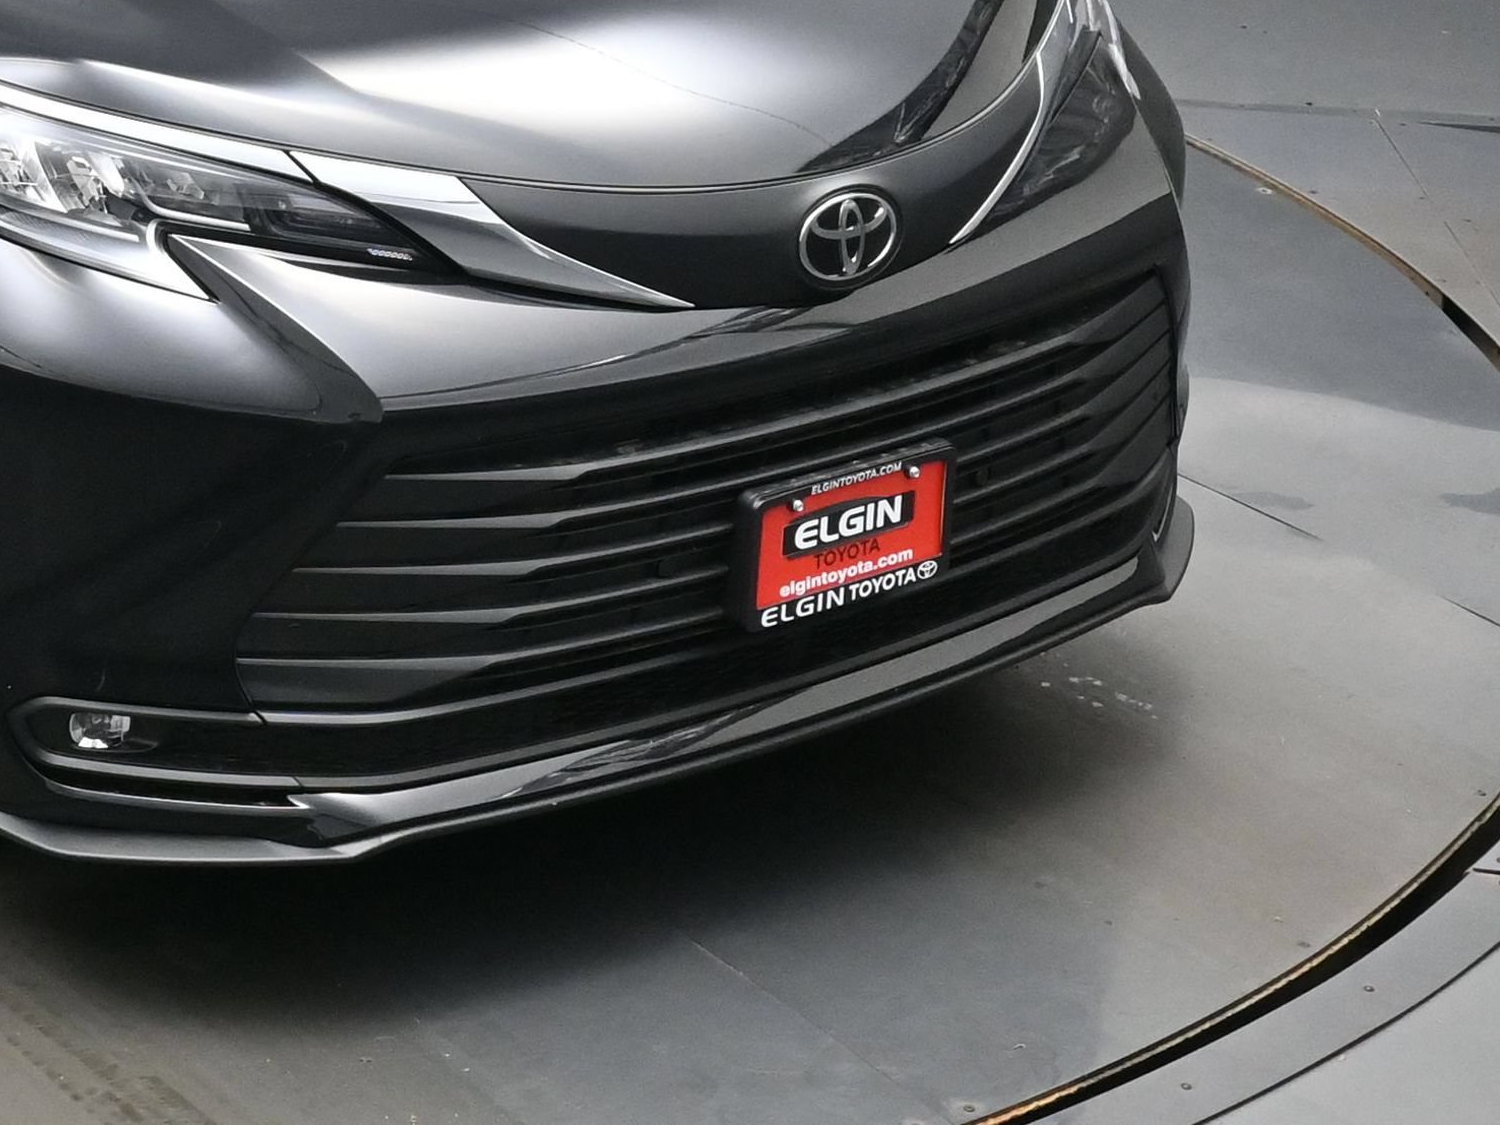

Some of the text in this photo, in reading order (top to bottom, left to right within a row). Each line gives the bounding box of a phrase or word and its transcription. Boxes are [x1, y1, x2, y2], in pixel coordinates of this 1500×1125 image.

[811, 461, 902, 495] ELGINTOYOTA.COM
[794, 495, 902, 550] ELGIN
[779, 548, 913, 597] elgintoyota.com
[813, 538, 881, 569] TOYOTA
[761, 568, 917, 627] ELGIN TOYOTA
